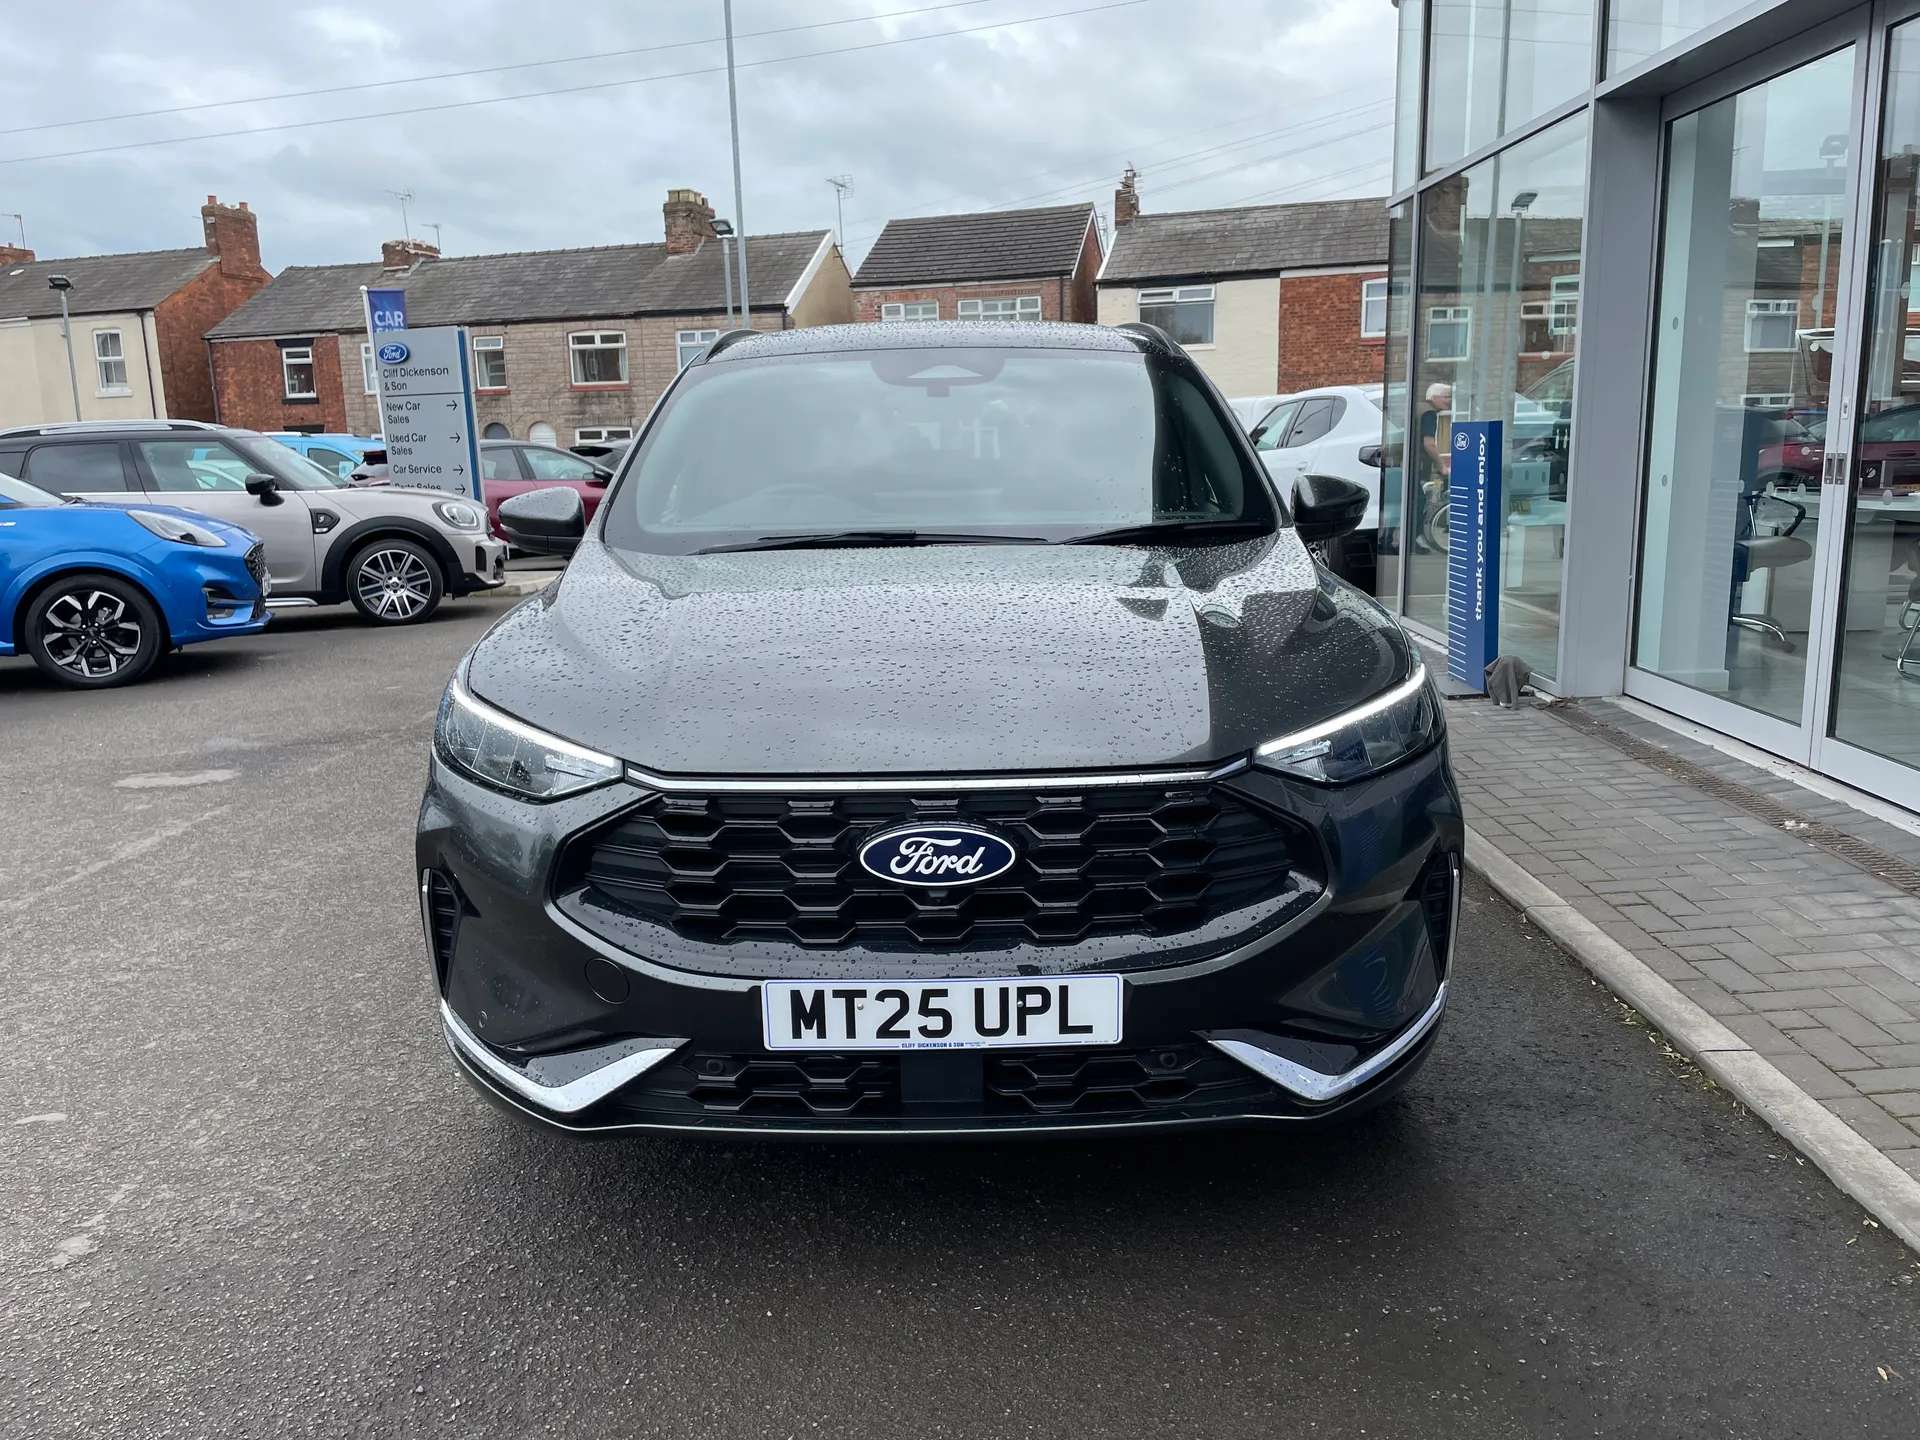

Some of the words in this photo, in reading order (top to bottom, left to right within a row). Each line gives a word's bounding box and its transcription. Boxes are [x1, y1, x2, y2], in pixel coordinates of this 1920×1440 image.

[375, 311, 404, 327] CAR
[383, 368, 398, 379] Cliff
[399, 366, 449, 378] Dickenson
[384, 383, 390, 391] &
[391, 382, 407, 391] Son
[386, 402, 403, 412] New
[405, 401, 421, 411] Car
[388, 415, 410, 424] Sales
[389, 433, 411, 443] Used
[412, 433, 427, 442] Car
[391, 446, 413, 456] Sales
[1478, 432, 1487, 486] enjoy
[393, 464, 407, 474] Car
[408, 464, 442, 474] Service
[1475, 569, 1483, 621] thank
[889, 836, 986, 875] Ford
[789, 988, 953, 1040] MT25
[973, 984, 1094, 1037] UPL
